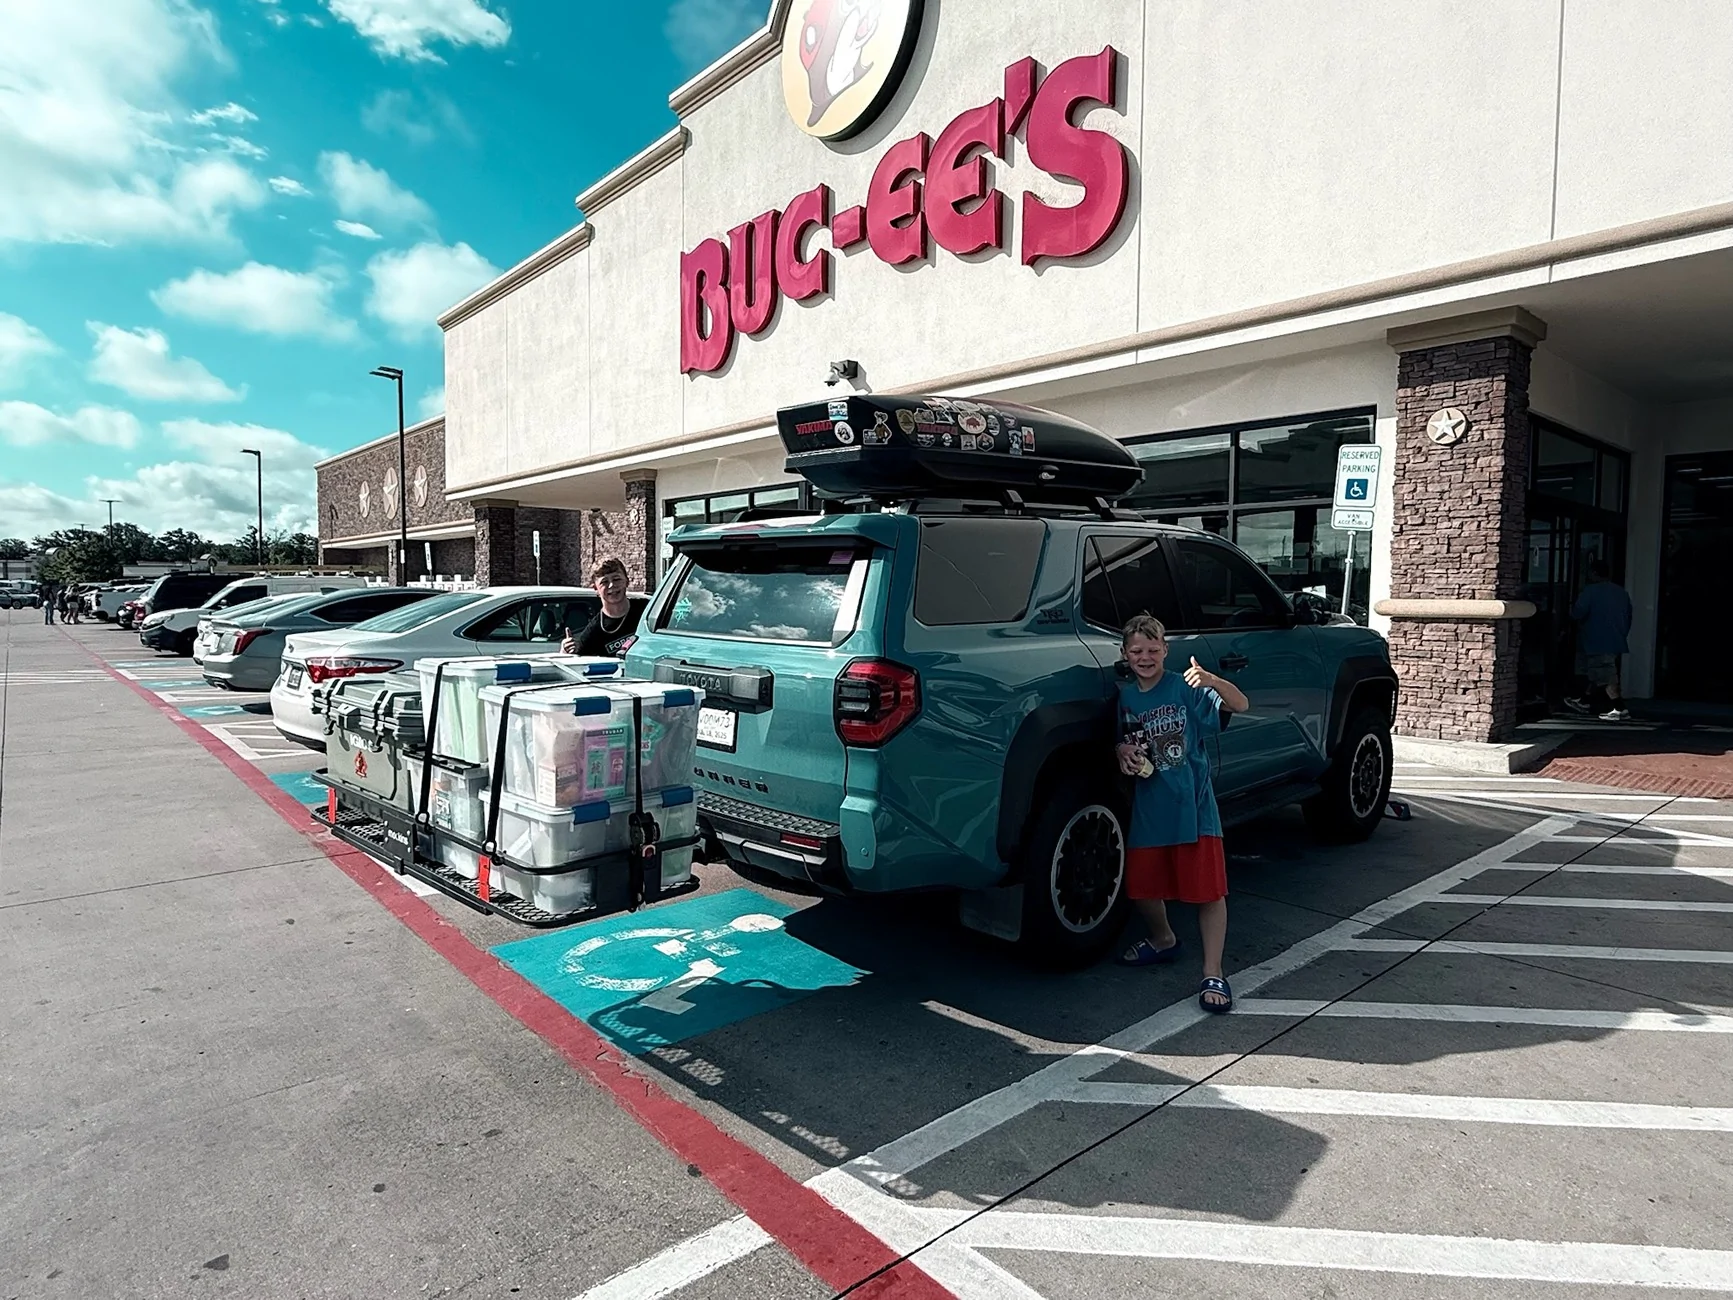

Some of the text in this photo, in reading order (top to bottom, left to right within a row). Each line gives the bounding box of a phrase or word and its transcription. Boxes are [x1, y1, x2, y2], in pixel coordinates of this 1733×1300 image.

[680, 45, 1128, 374] BUC-EE'S
[795, 420, 833, 435] YAKIMA
[1341, 451, 1379, 460] RESERVED
[1342, 464, 1376, 473] PARKING
[679, 673, 722, 691] TOYOTA
